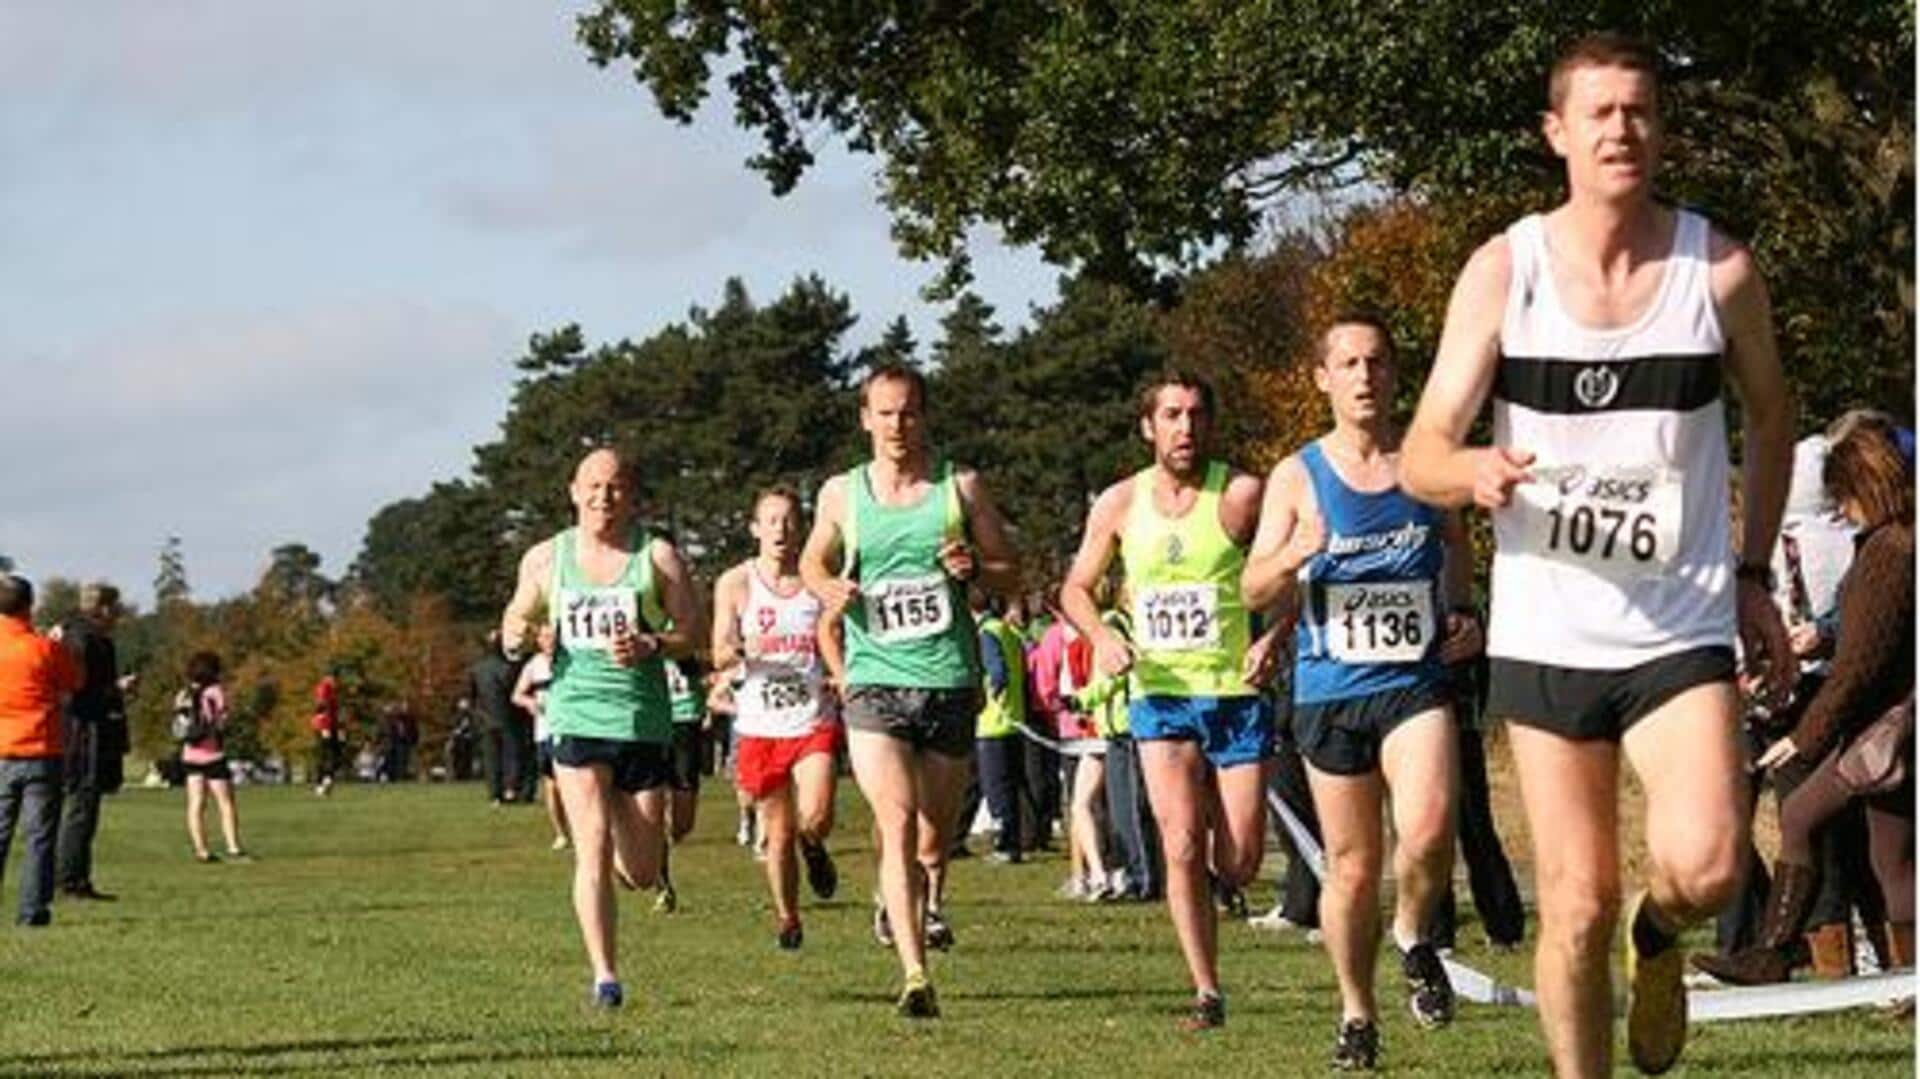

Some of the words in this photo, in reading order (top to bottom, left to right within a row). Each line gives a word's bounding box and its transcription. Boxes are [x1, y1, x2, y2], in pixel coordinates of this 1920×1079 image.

[1548, 505, 1656, 561] 1076
[876, 594, 941, 631] 1155
[1147, 609, 1209, 639] 1012
[1344, 610, 1422, 649] 1136
